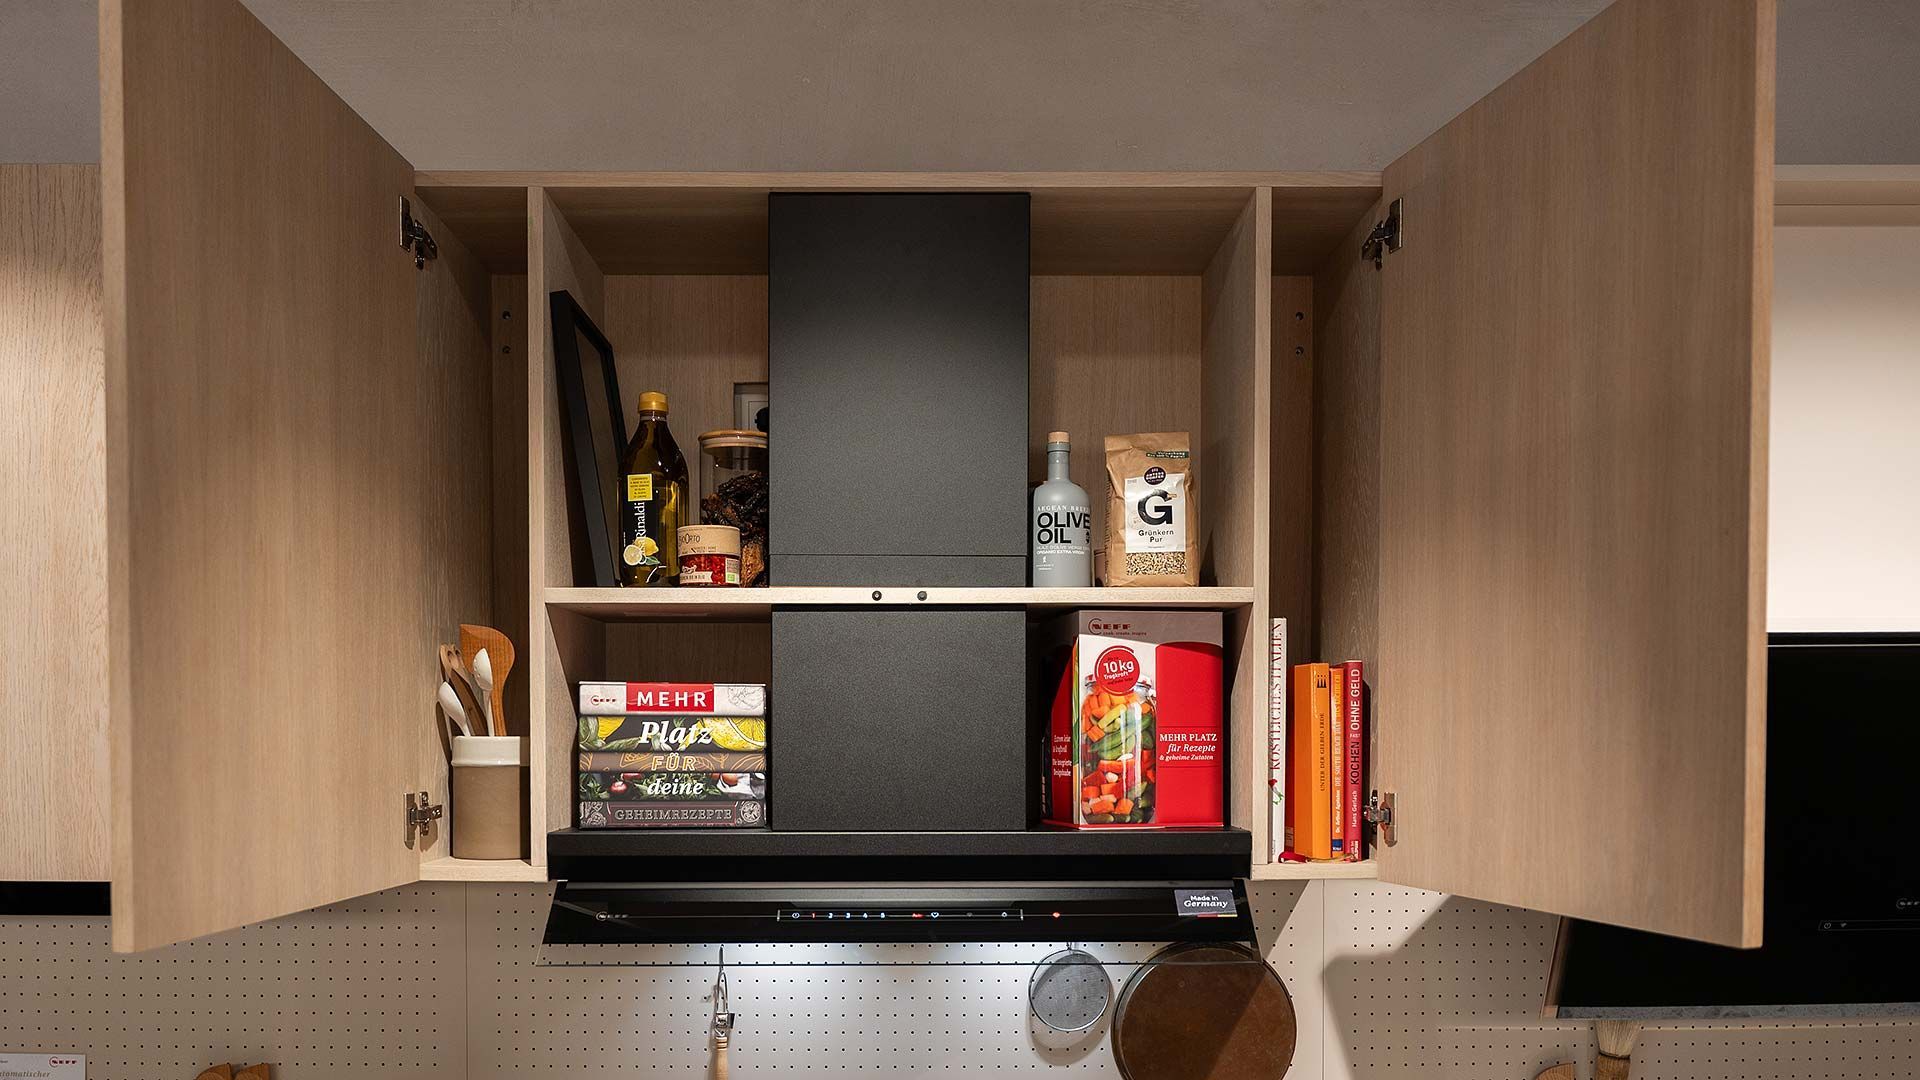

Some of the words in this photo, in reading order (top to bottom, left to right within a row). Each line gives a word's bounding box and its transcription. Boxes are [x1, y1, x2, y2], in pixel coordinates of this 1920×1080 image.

[1037, 511, 1090, 529] OLIVE
[1037, 528, 1072, 544] OIL
[1103, 661, 1118, 673] 10
[1119, 660, 1135, 673] kg
[1350, 669, 1360, 697] GELD
[637, 691, 707, 707] MEHR
[1350, 701, 1360, 730] OHNE
[639, 721, 713, 744] Platz
[1160, 733, 1187, 741] MEHR
[1189, 733, 1217, 742] PLATZ
[1166, 743, 1181, 754] für
[1183, 743, 1216, 753] Rezepte
[651, 753, 696, 770] FÜR
[1350, 741, 1360, 785] KOCHEN
[647, 778, 704, 795] deine
[615, 809, 732, 820] GEHEIMREZEPTE
[1183, 900, 1228, 909] Germany
